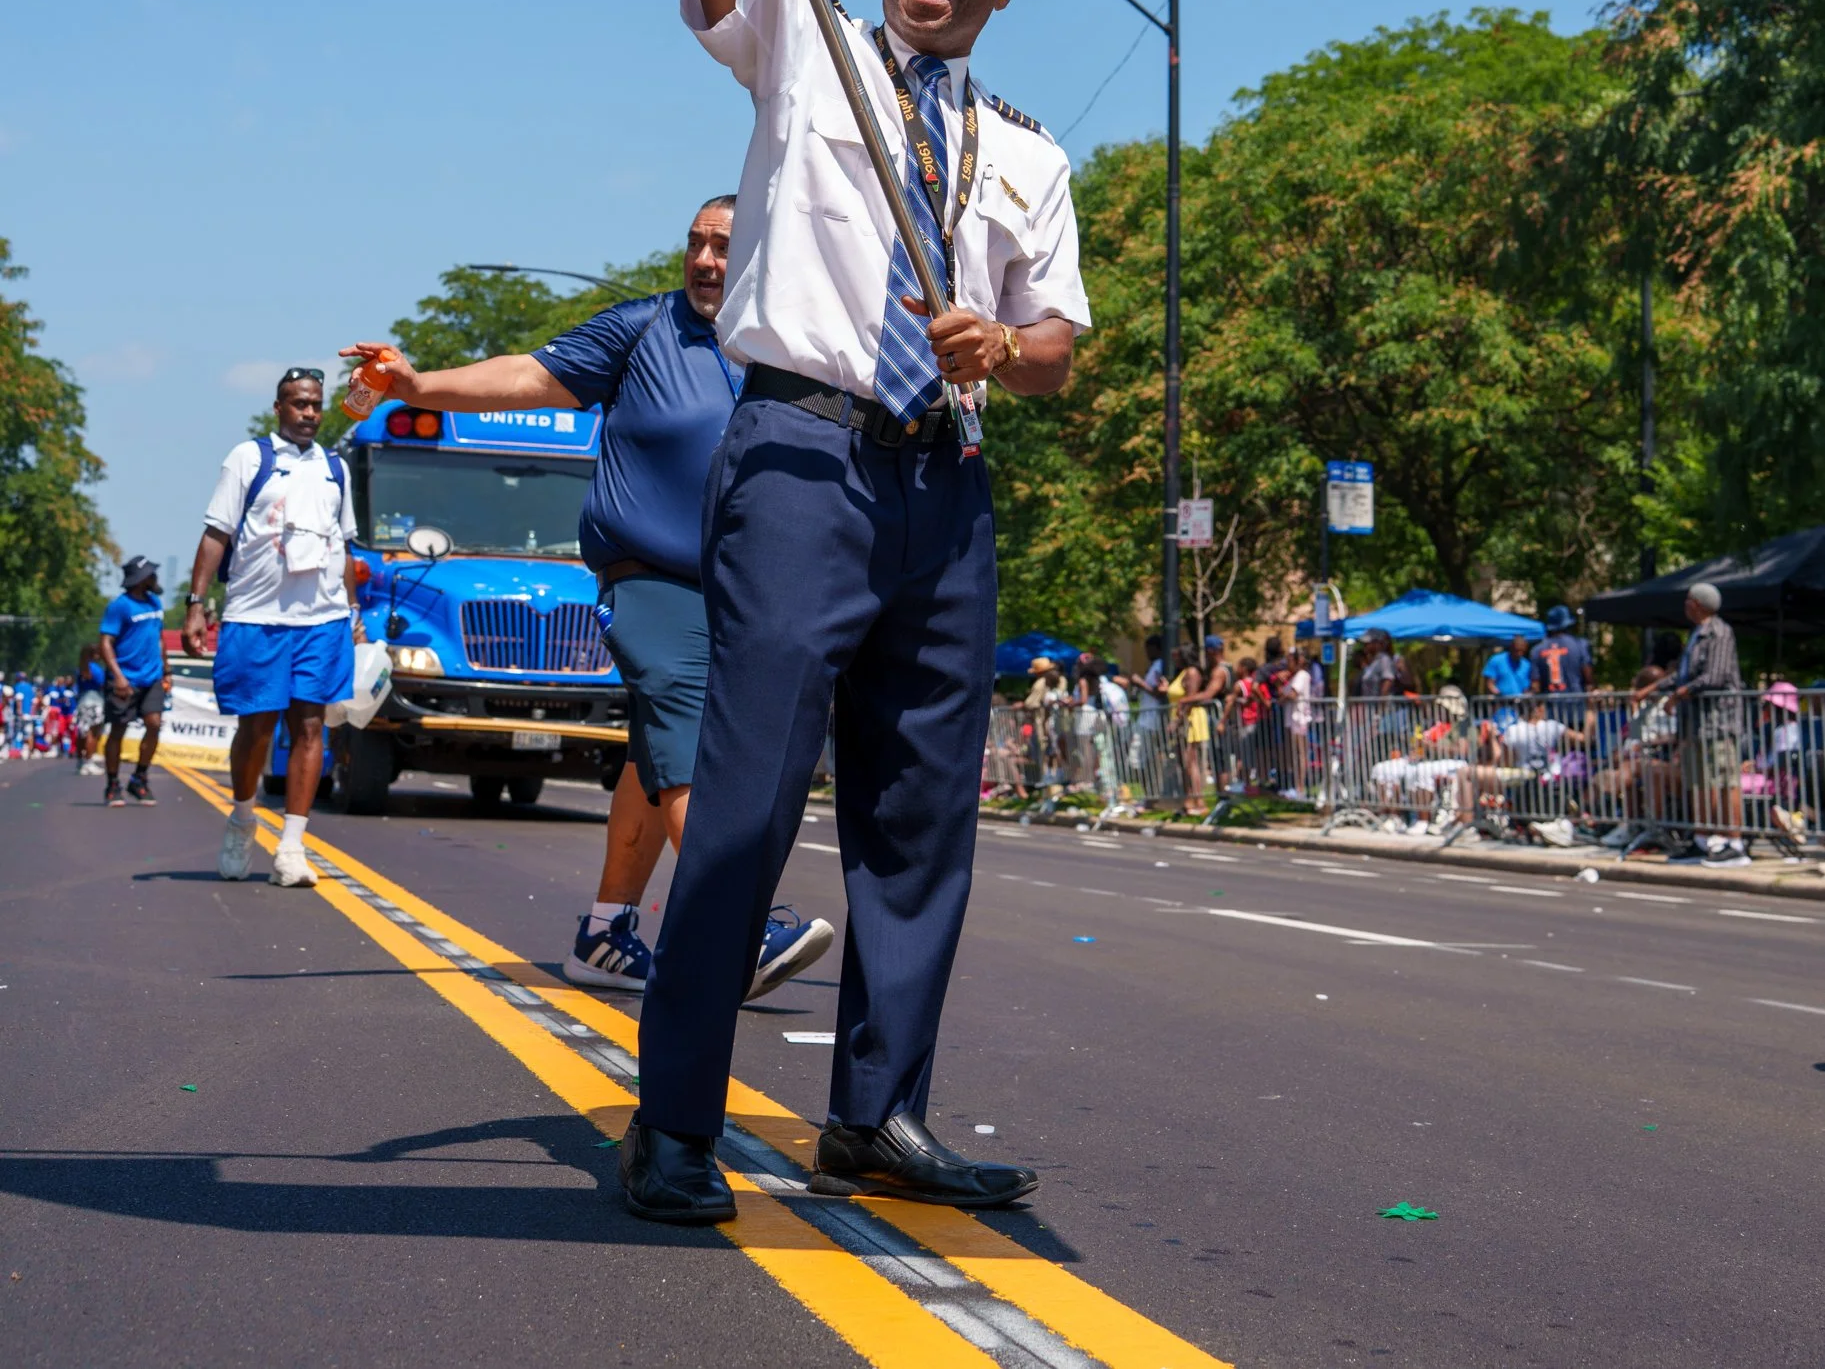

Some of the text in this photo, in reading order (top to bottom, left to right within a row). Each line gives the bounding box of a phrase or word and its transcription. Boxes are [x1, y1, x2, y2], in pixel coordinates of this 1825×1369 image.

[896, 87, 915, 121] Alpha
[965, 106, 976, 137] Alpha
[961, 151, 974, 183] 1906
[479, 411, 551, 427] UNITED
[171, 720, 228, 738] WHITE
